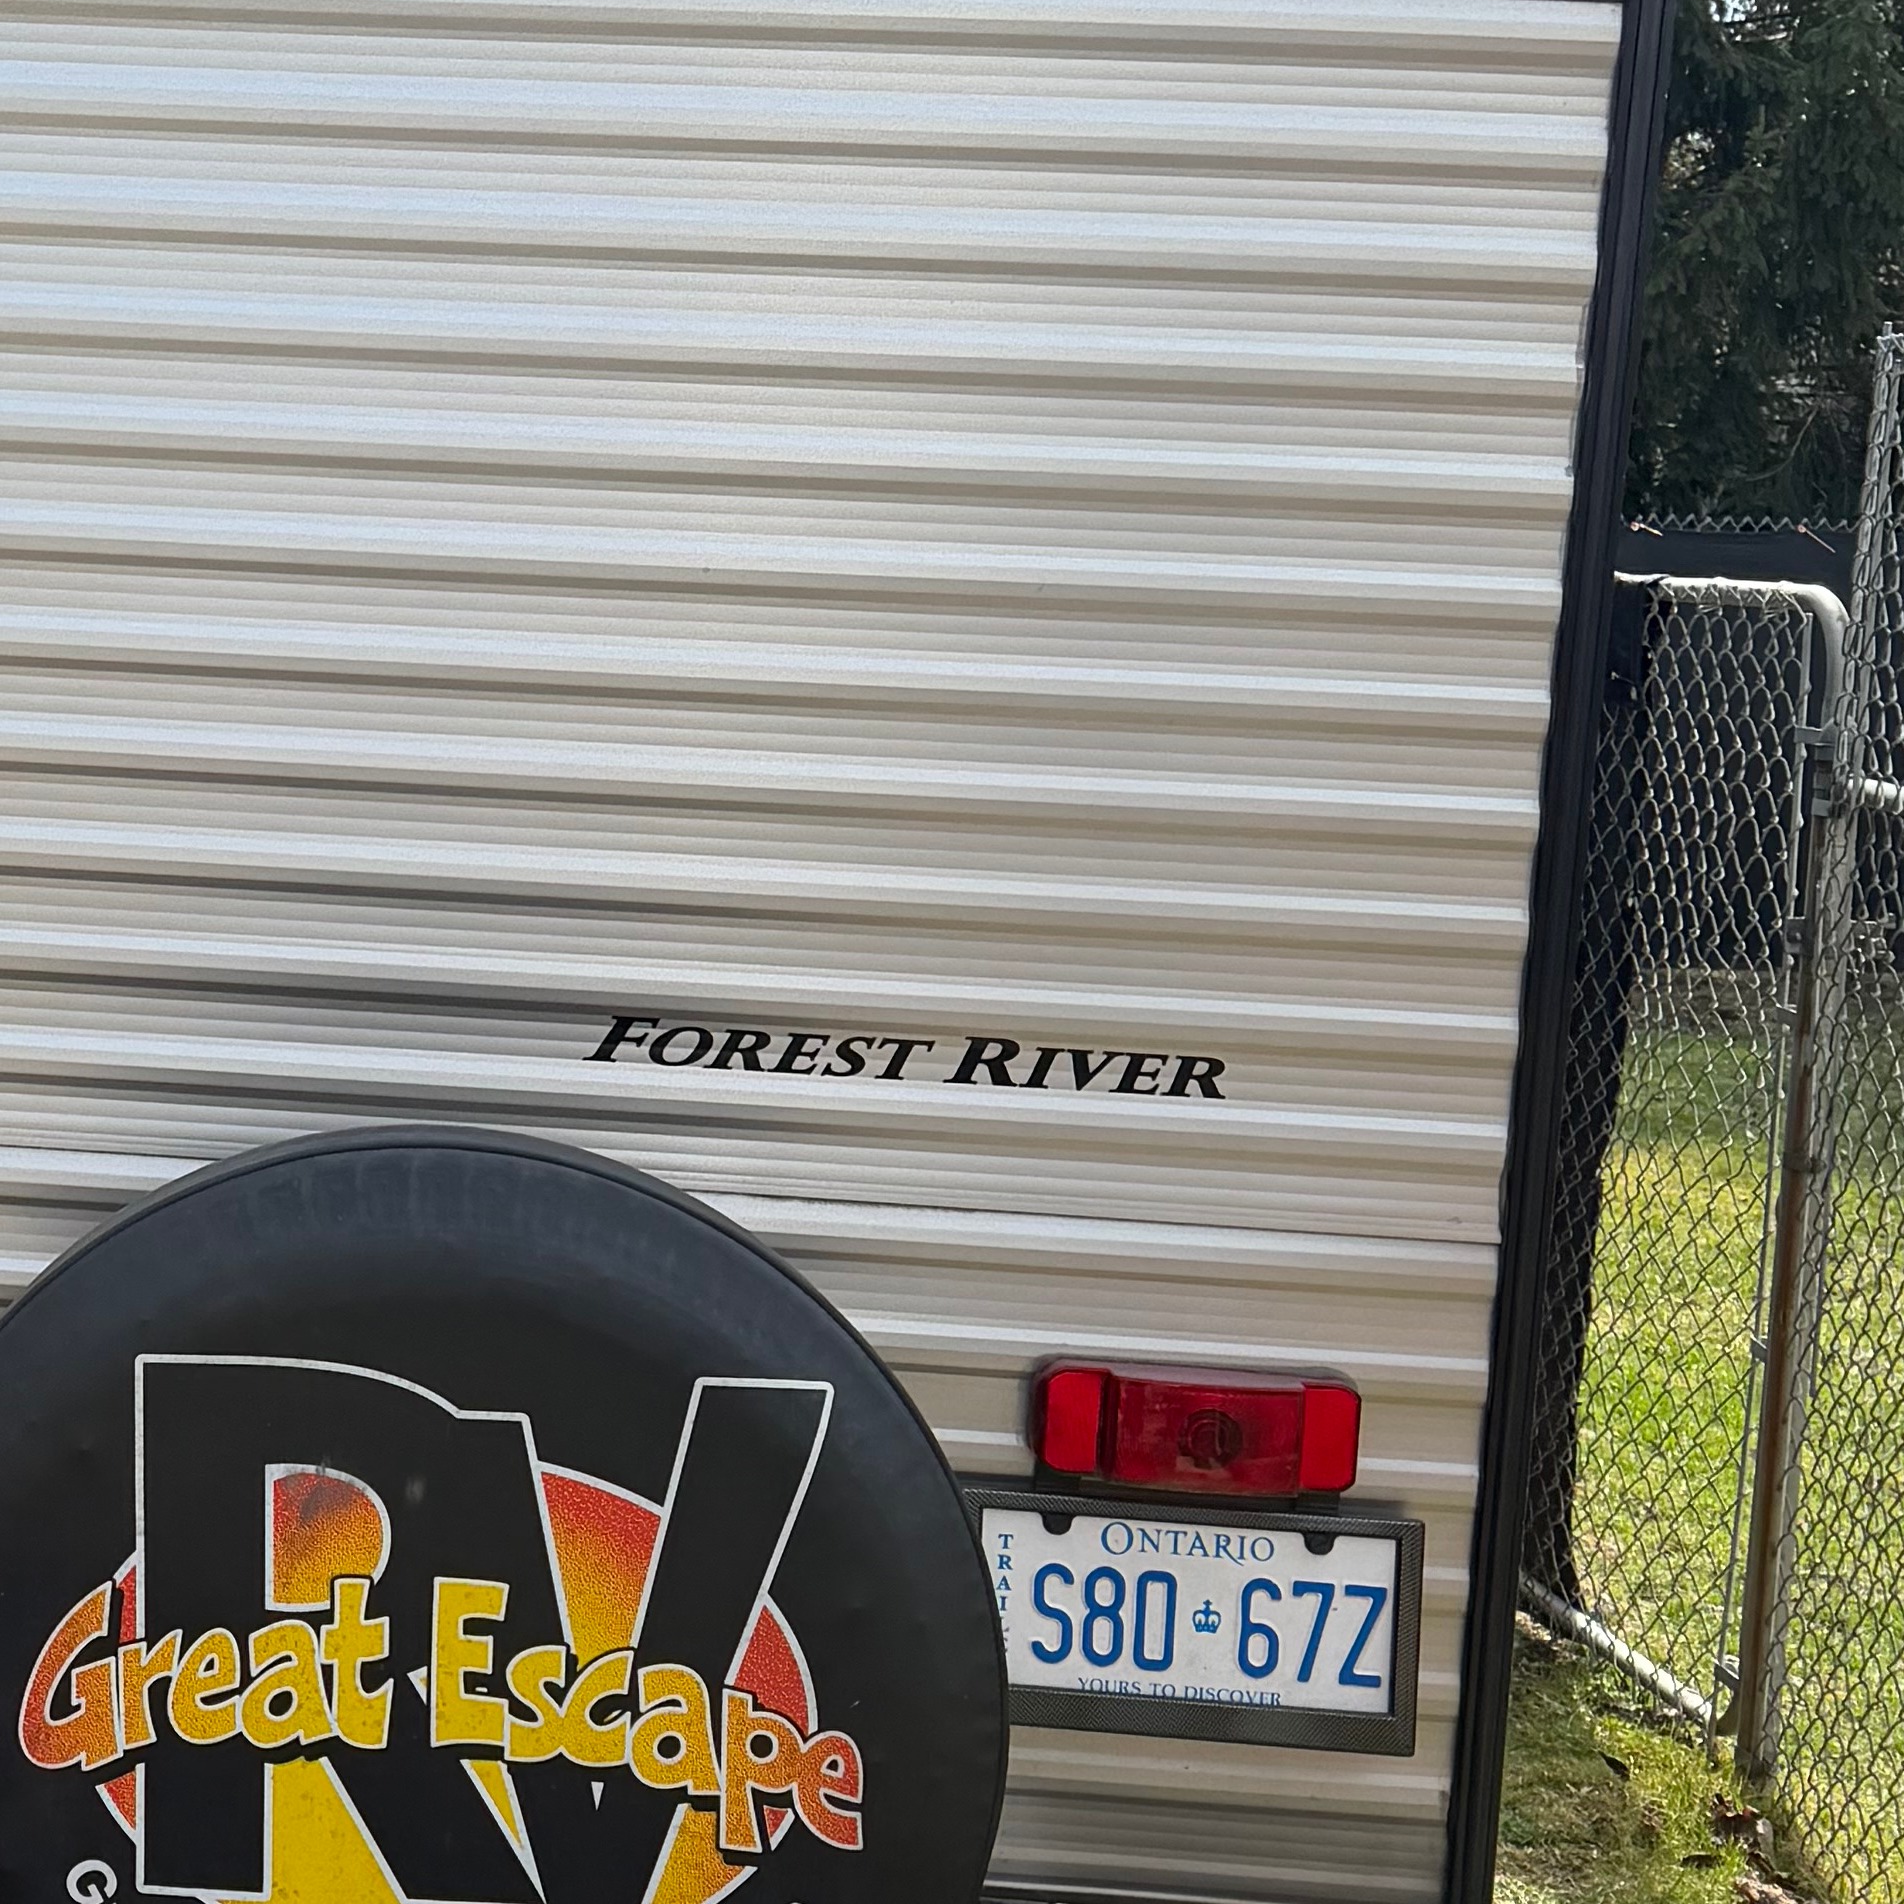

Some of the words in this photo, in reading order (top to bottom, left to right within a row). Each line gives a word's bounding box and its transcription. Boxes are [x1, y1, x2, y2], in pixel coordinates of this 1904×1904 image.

[583, 1015, 936, 1081] FOREST
[943, 1036, 1228, 1100] RIVER
[996, 1534, 1014, 1653] TRAI
[1100, 1521, 1276, 1566] ONTARIO
[1031, 1562, 1179, 1673] S80
[1237, 1577, 1389, 1689] 67Z
[17, 1576, 393, 1773] Great
[427, 1576, 865, 1855] Escape
[1077, 1677, 1142, 1695] YOURS
[1149, 1683, 1176, 1697] TO
[1184, 1686, 1281, 1706] DISCOVER
